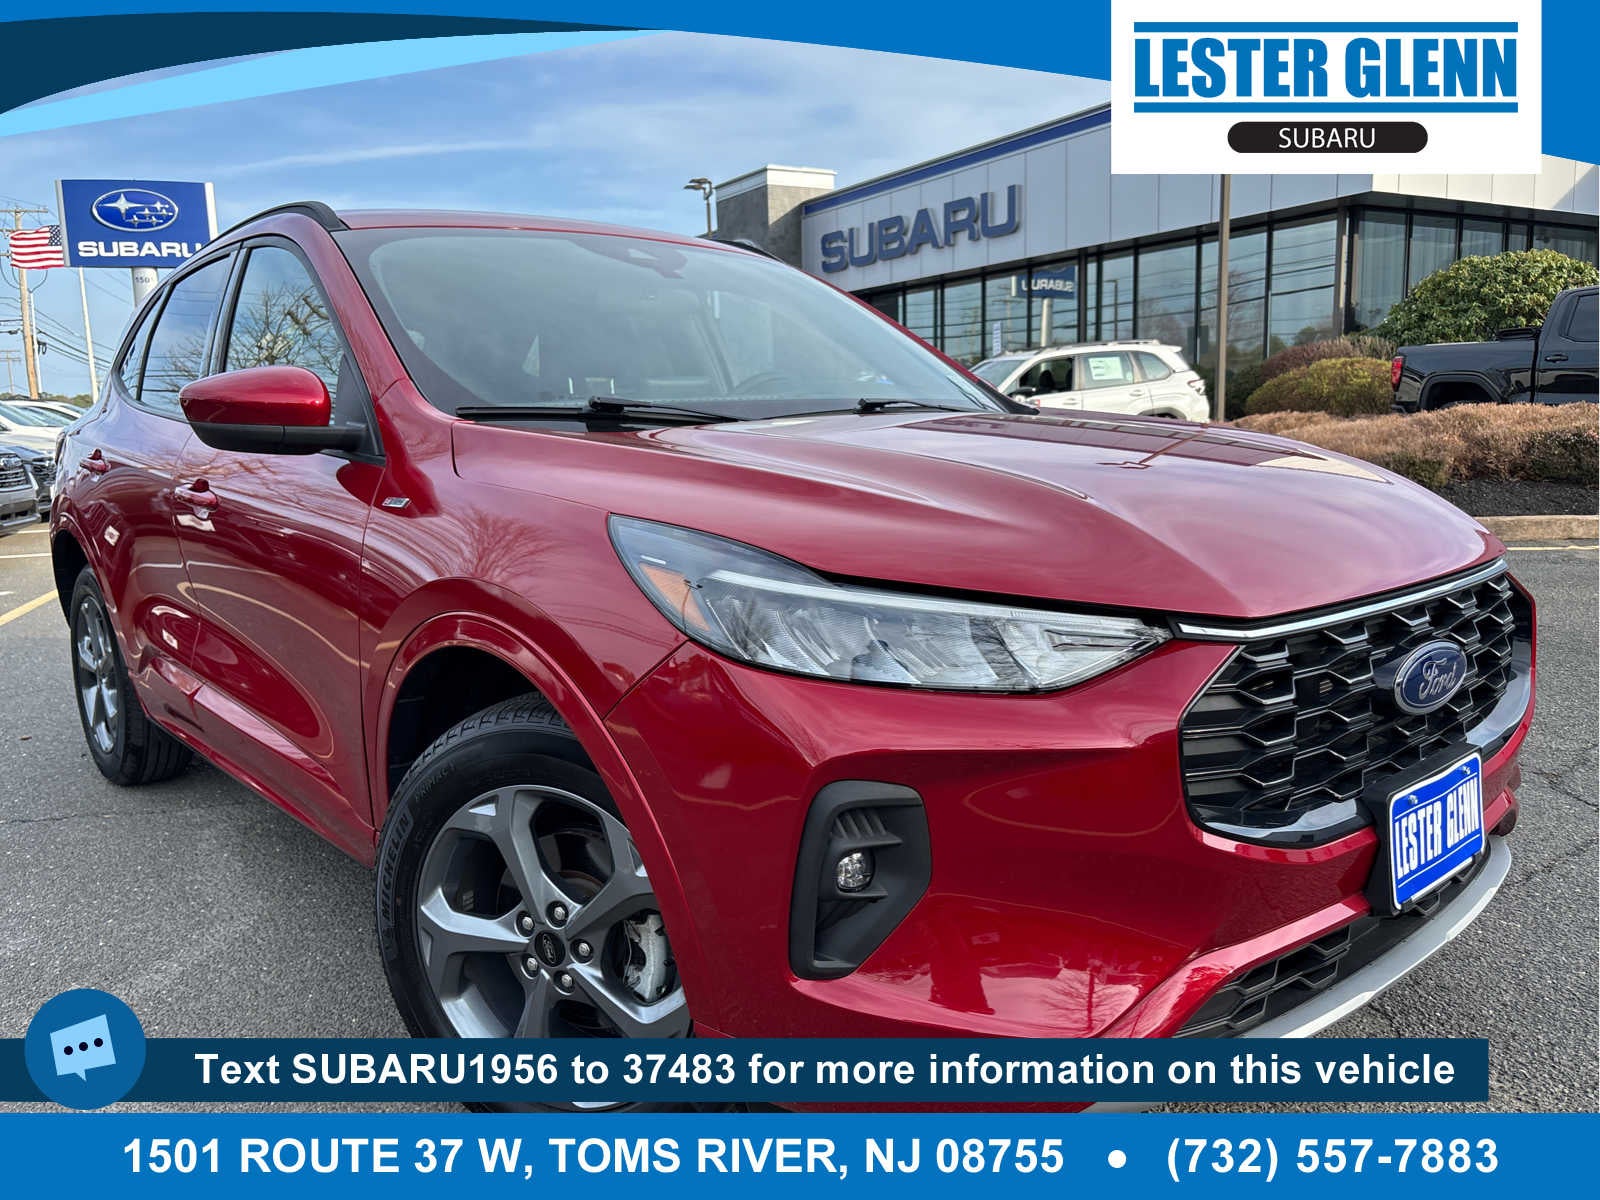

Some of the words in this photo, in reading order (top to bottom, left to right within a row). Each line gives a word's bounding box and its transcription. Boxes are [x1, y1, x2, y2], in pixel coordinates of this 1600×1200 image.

[820, 184, 1021, 273] SUBARU
[1418, 658, 1458, 699] Ford
[381, 811, 411, 920] MICHELIN
[1394, 801, 1443, 879] LESTER
[1446, 776, 1480, 849] GLENN
